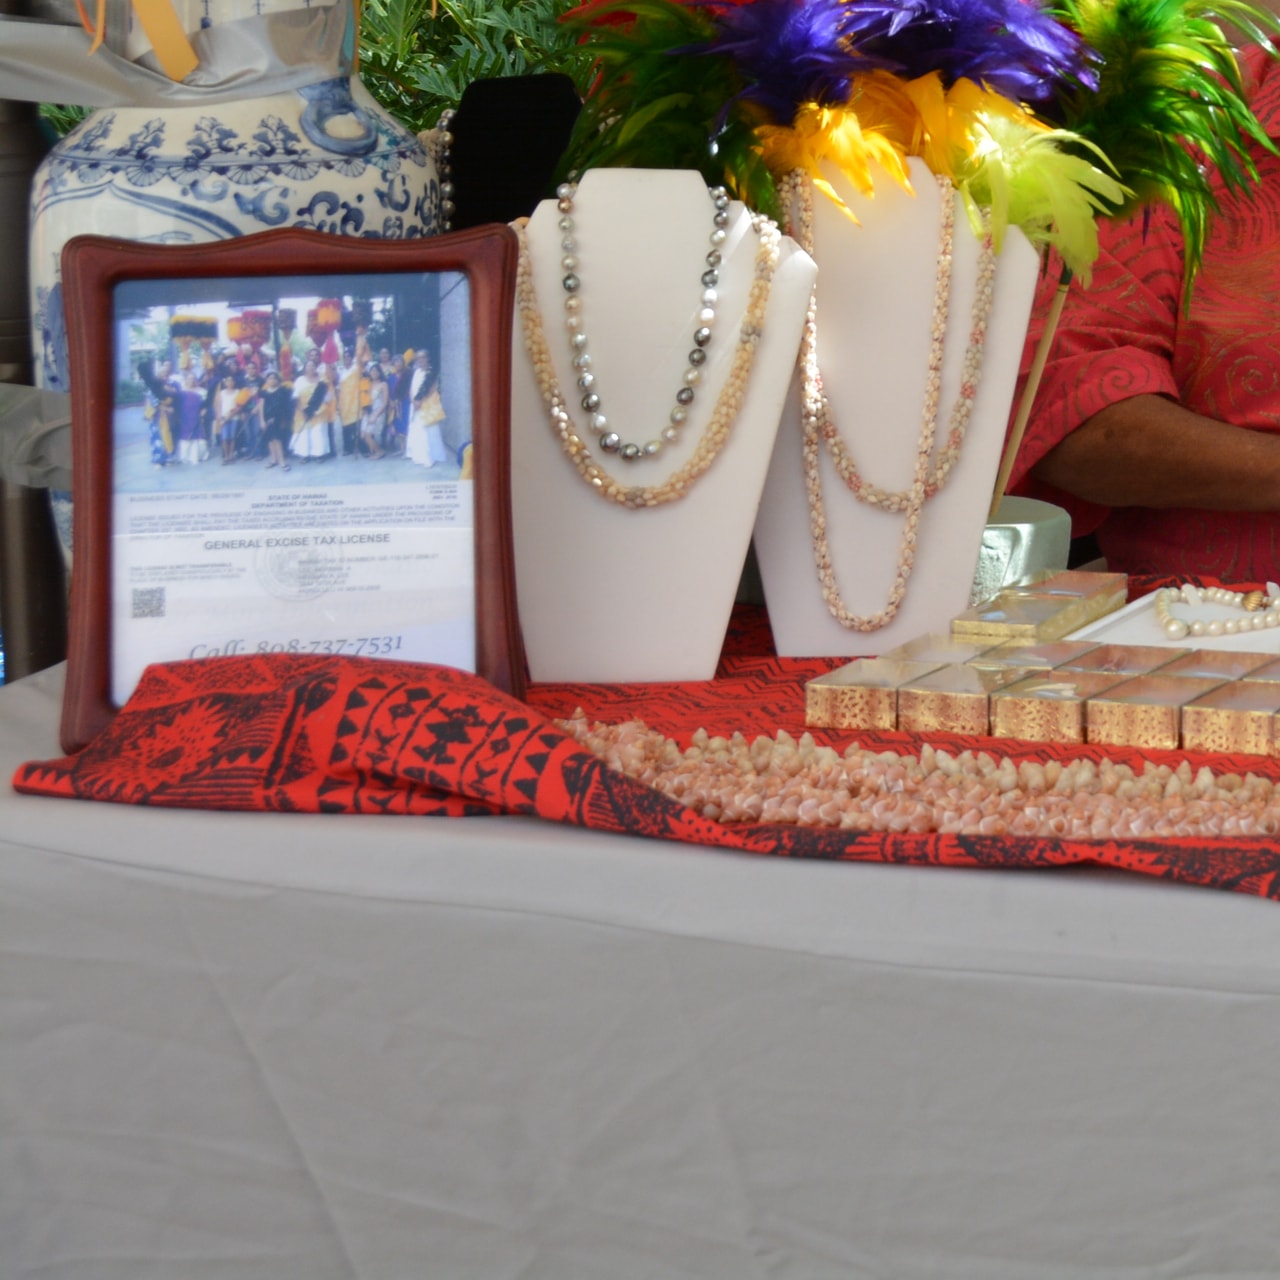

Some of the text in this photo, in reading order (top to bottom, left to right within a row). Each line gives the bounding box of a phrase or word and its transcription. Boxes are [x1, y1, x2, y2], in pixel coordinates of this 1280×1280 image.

[204, 533, 391, 551] GENERAL EXCISE TAX LICENSE
